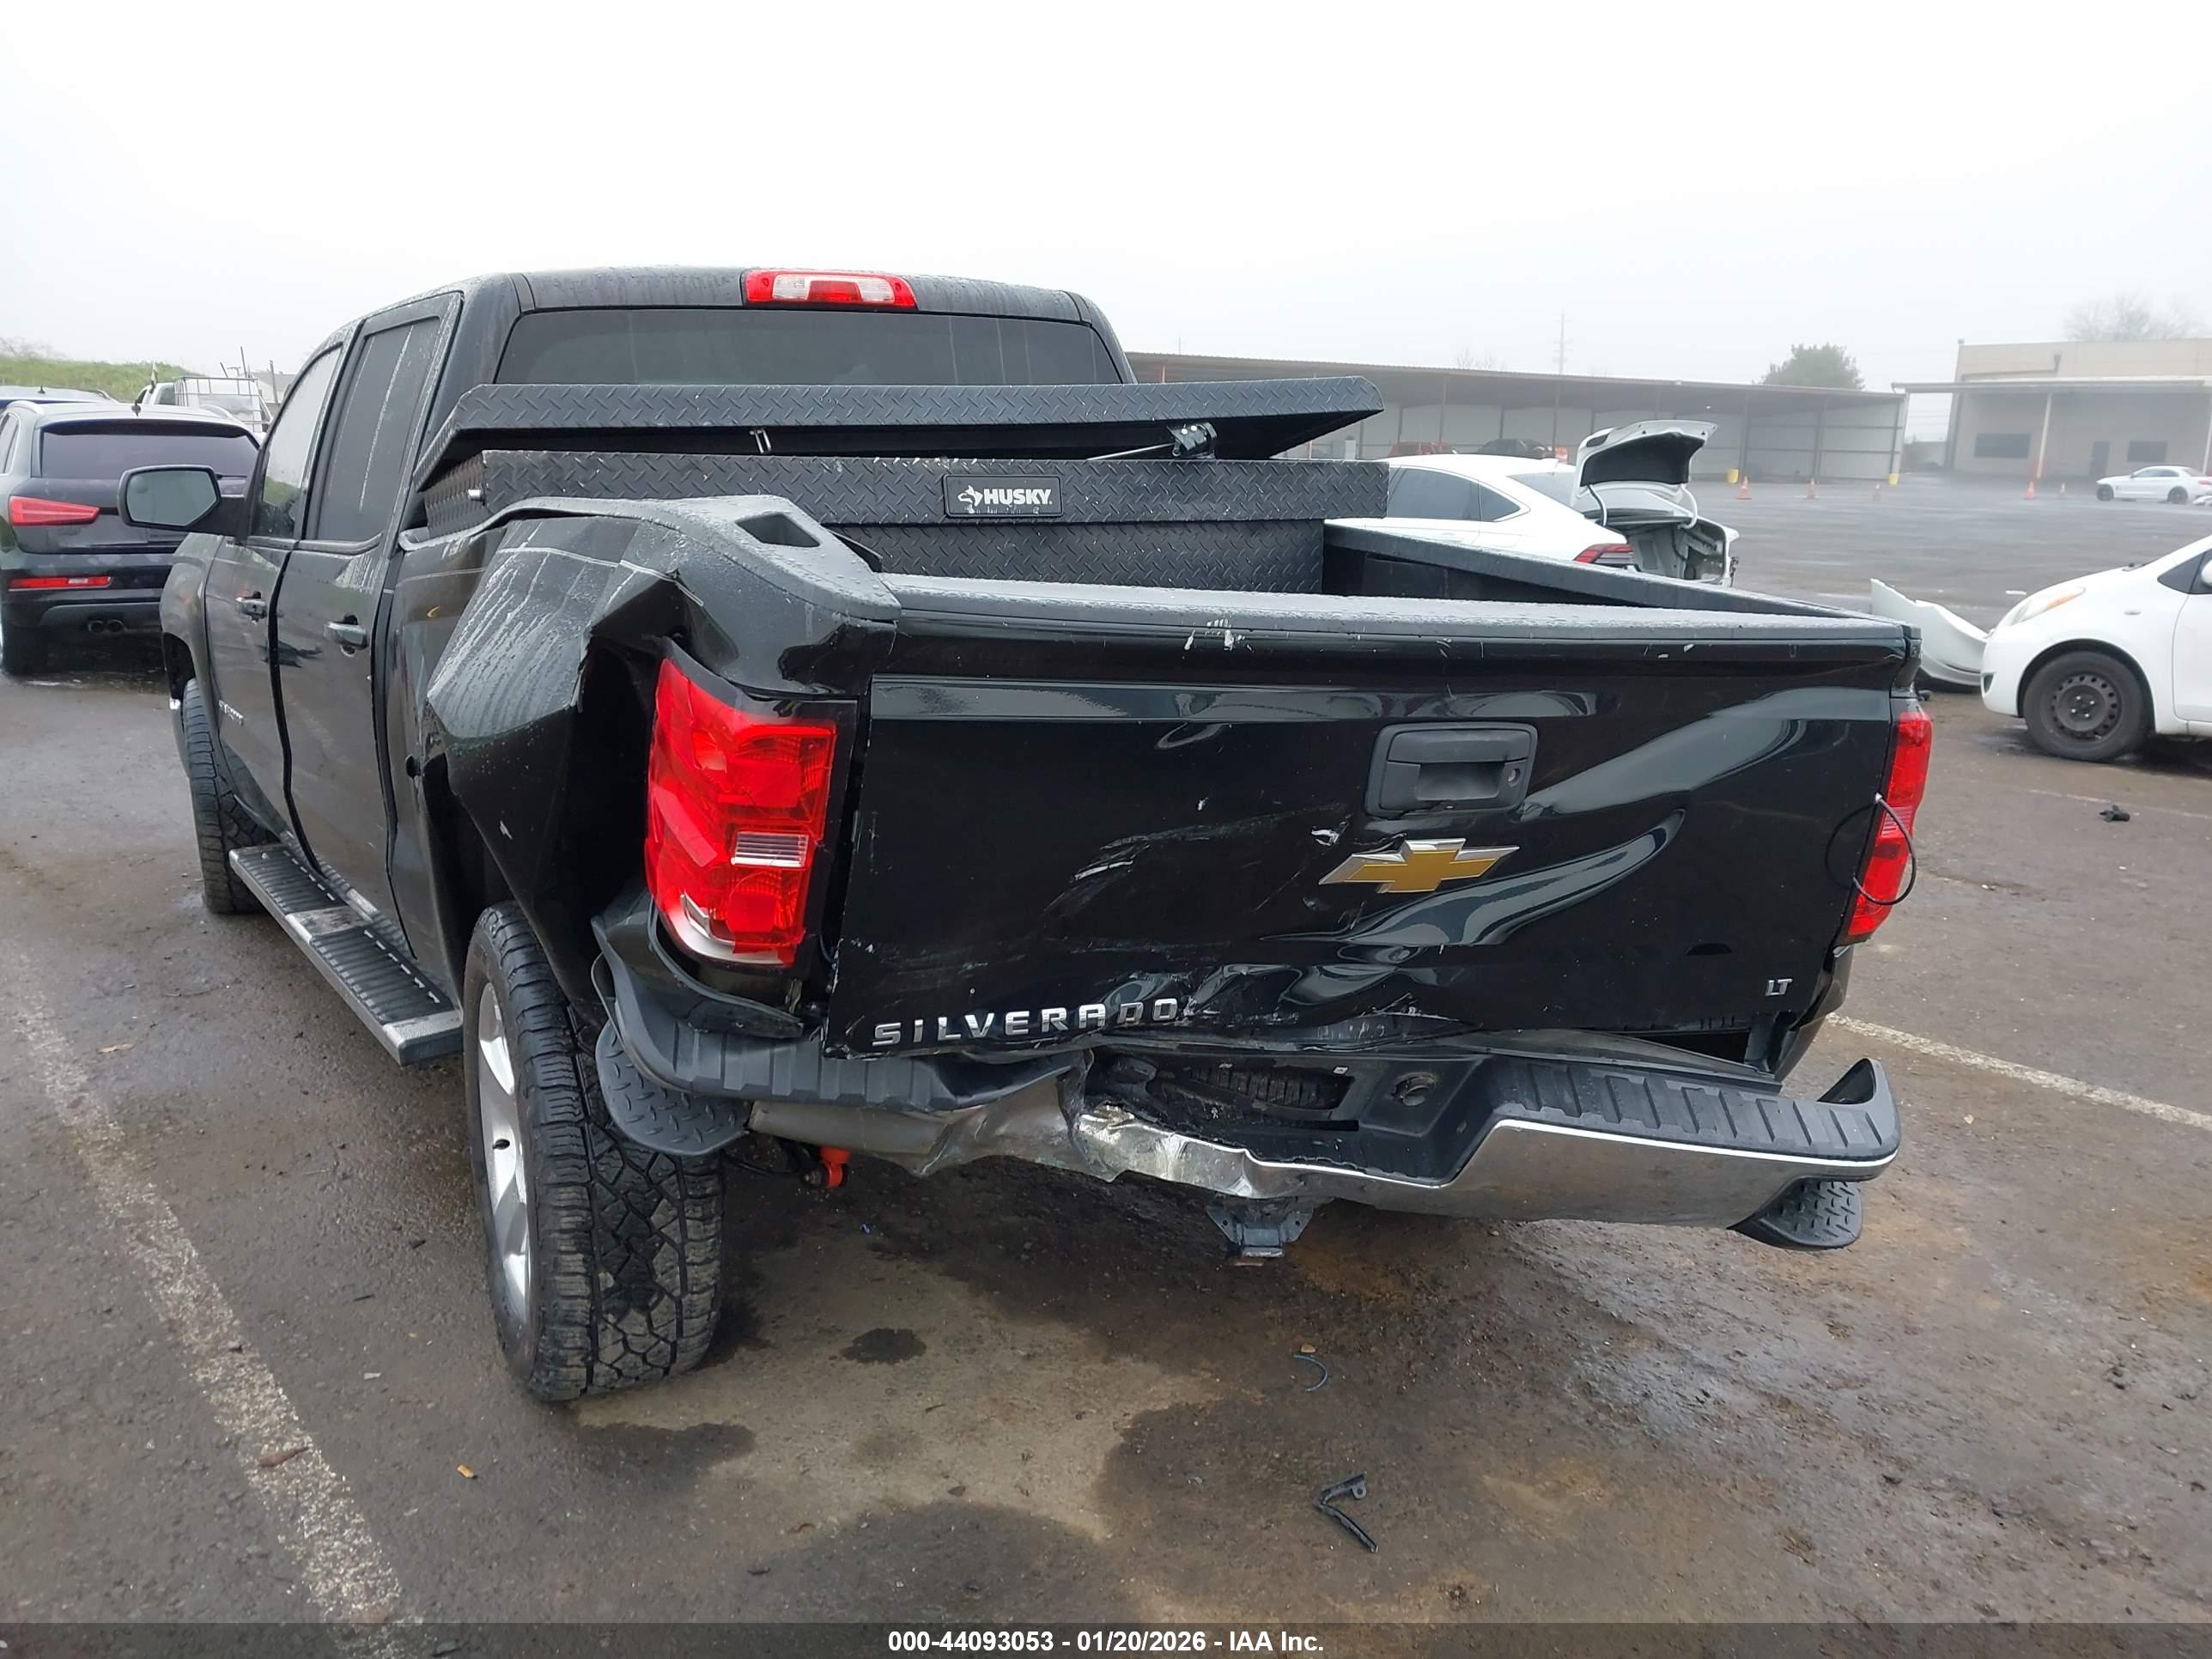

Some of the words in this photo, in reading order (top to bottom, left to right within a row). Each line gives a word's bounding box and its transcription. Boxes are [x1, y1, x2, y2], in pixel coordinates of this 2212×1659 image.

[983, 488, 1052, 505] HUSKY
[1765, 978, 1793, 996] LT
[872, 998, 1177, 1047] SILVERADO
